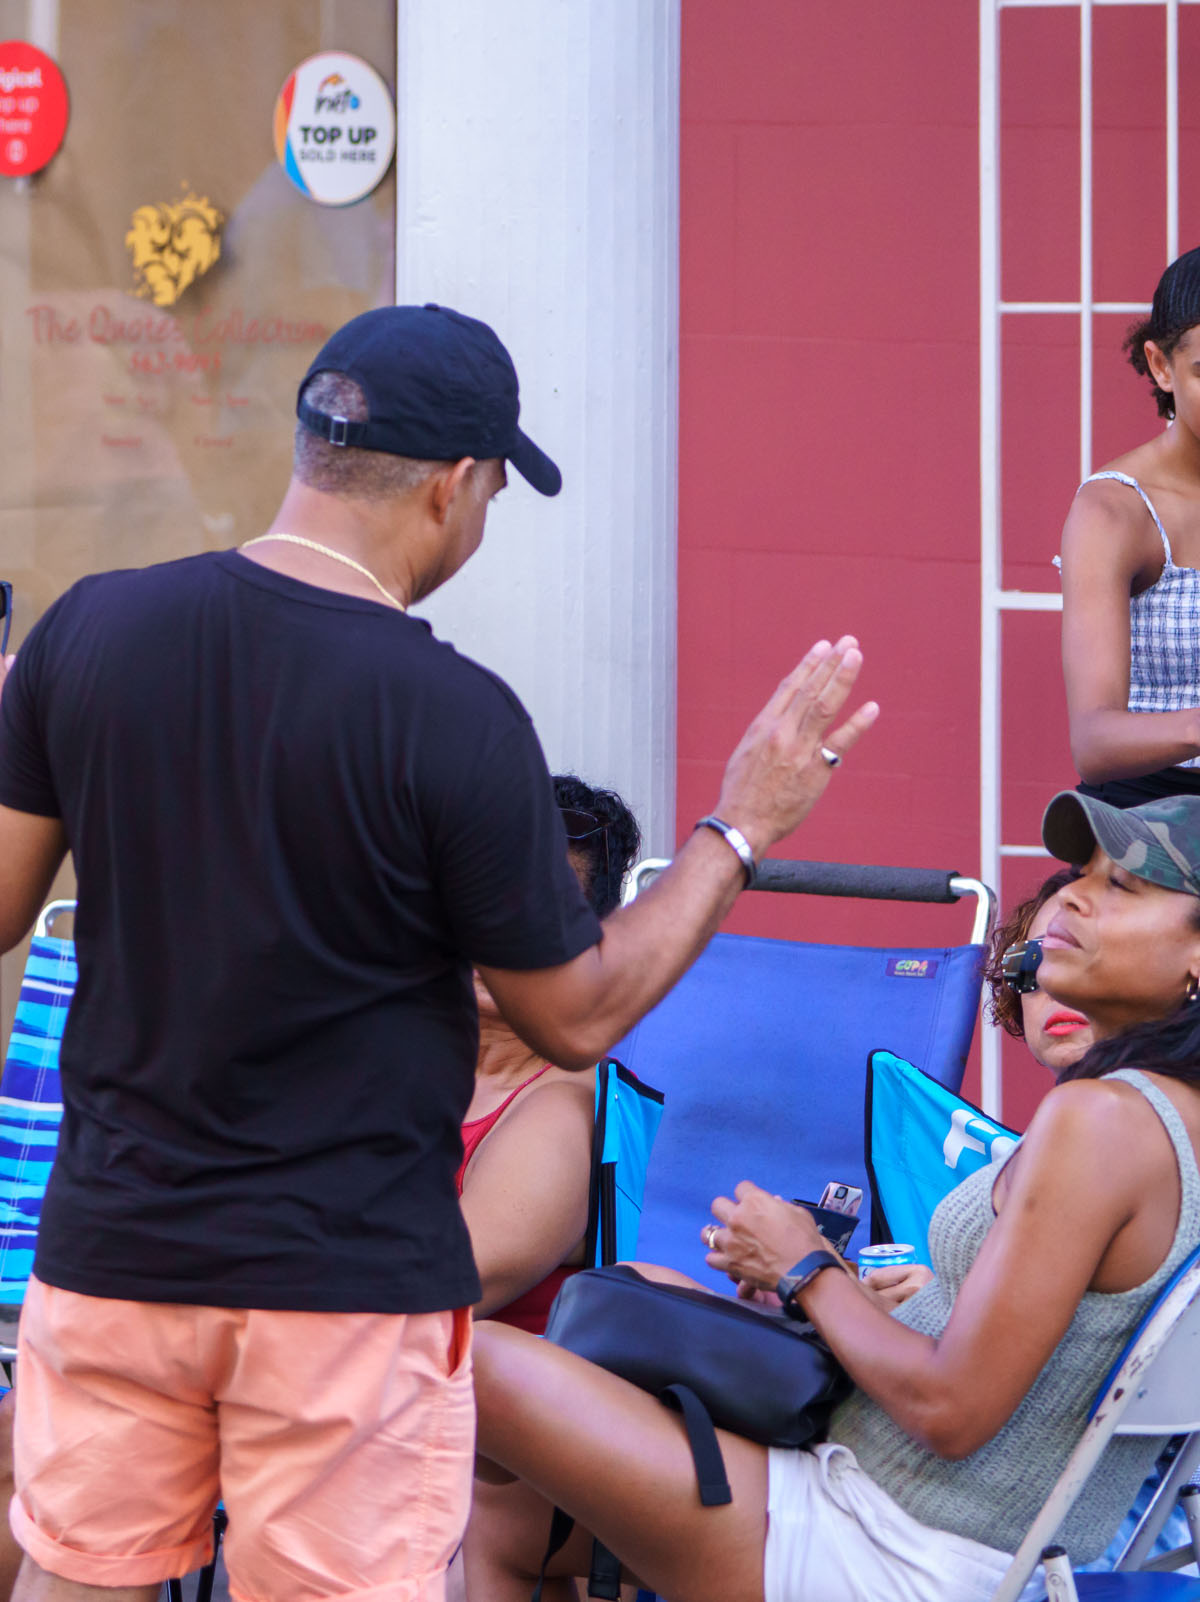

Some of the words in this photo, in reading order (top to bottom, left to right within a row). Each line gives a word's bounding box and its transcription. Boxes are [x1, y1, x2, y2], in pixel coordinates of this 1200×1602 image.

[300, 127, 342, 144] TOP
[348, 127, 377, 144] UP
[301, 149, 336, 162] SOLD
[342, 149, 377, 162] HERE
[26, 304, 80, 344] The
